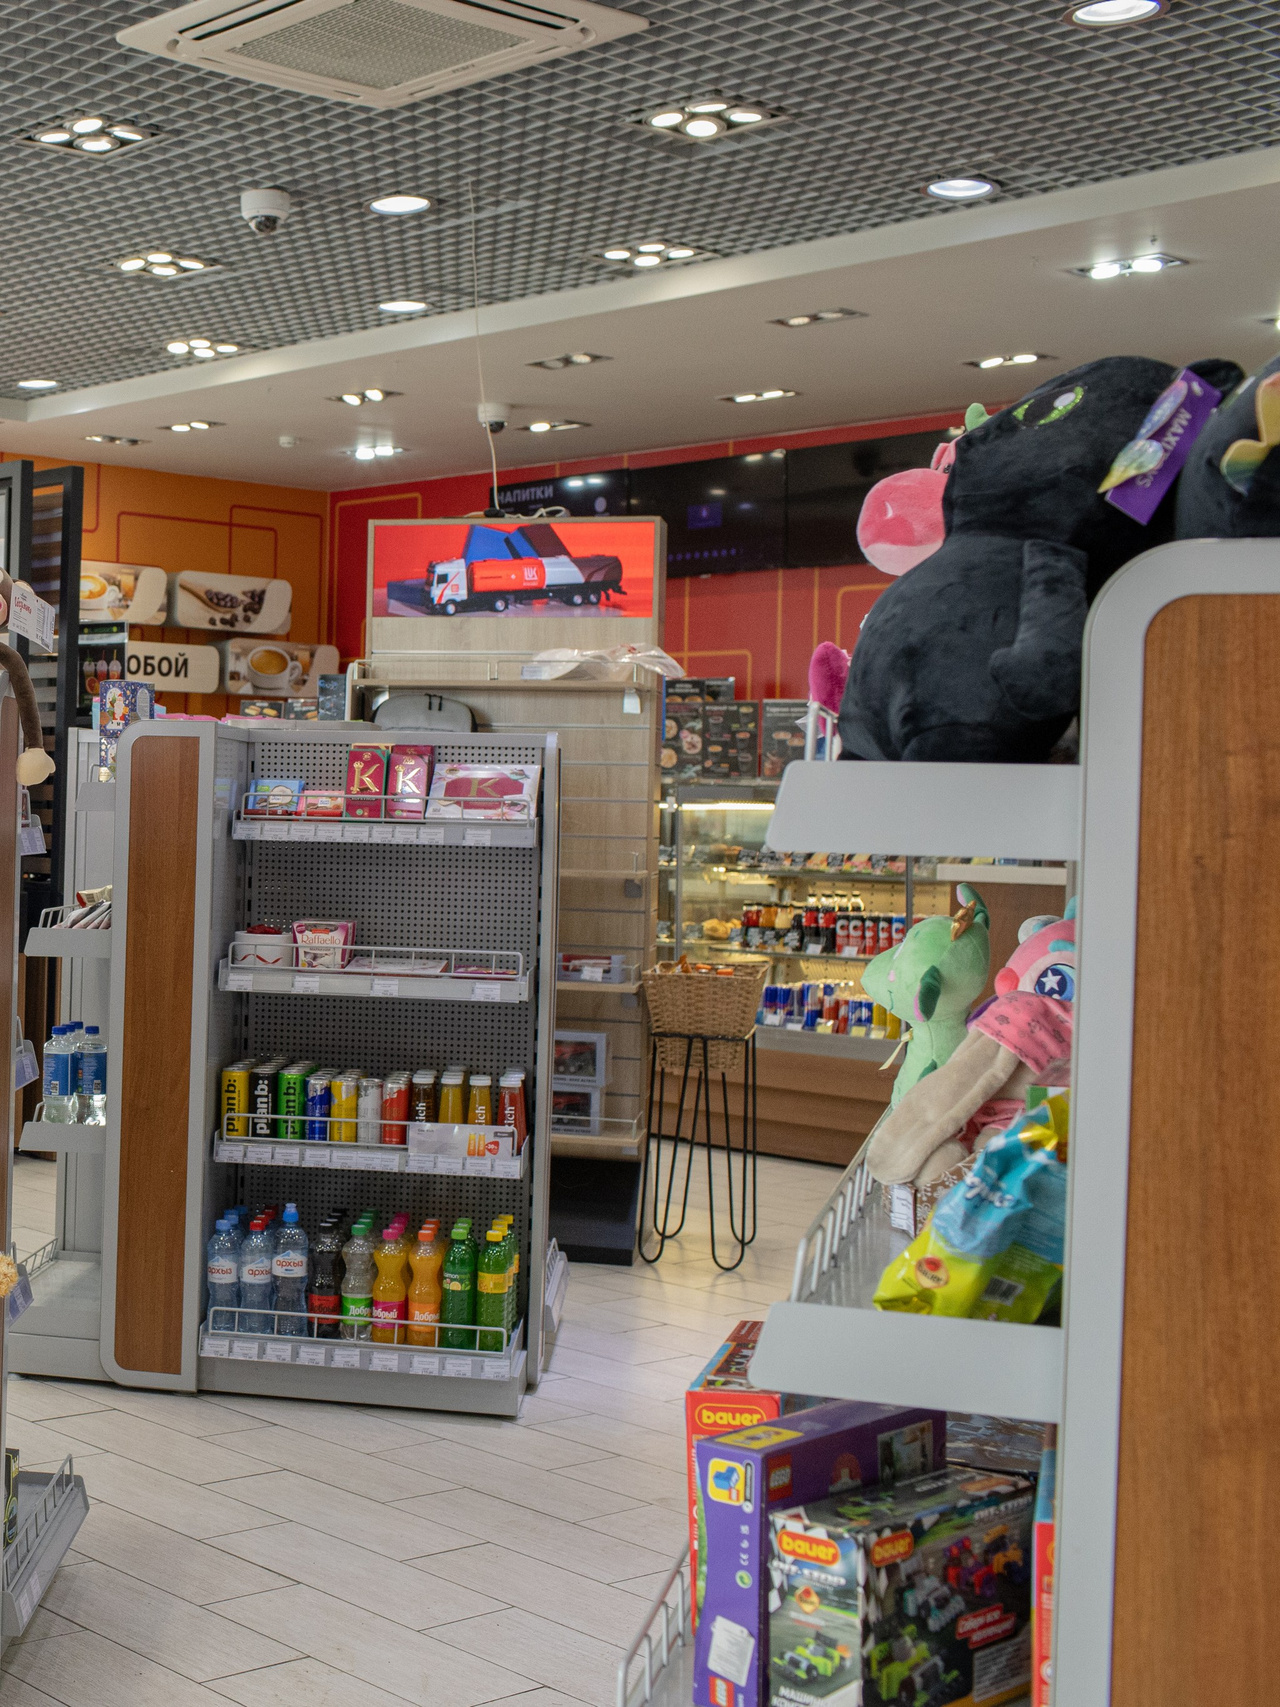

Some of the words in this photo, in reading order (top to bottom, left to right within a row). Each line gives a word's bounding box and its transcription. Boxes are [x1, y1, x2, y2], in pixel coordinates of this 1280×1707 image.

[497, 485, 554, 503] НАПИТКИ
[127, 653, 189, 678] ОБОЙ
[301, 934, 341, 945] Raffaello
[256, 1097, 270, 1134] plan
[416, 1102, 426, 1123] ich
[475, 1105, 486, 1126] ich
[276, 1259, 304, 1269] архыз
[701, 1409, 762, 1426] bauer
[782, 1535, 836, 1562] bauer
